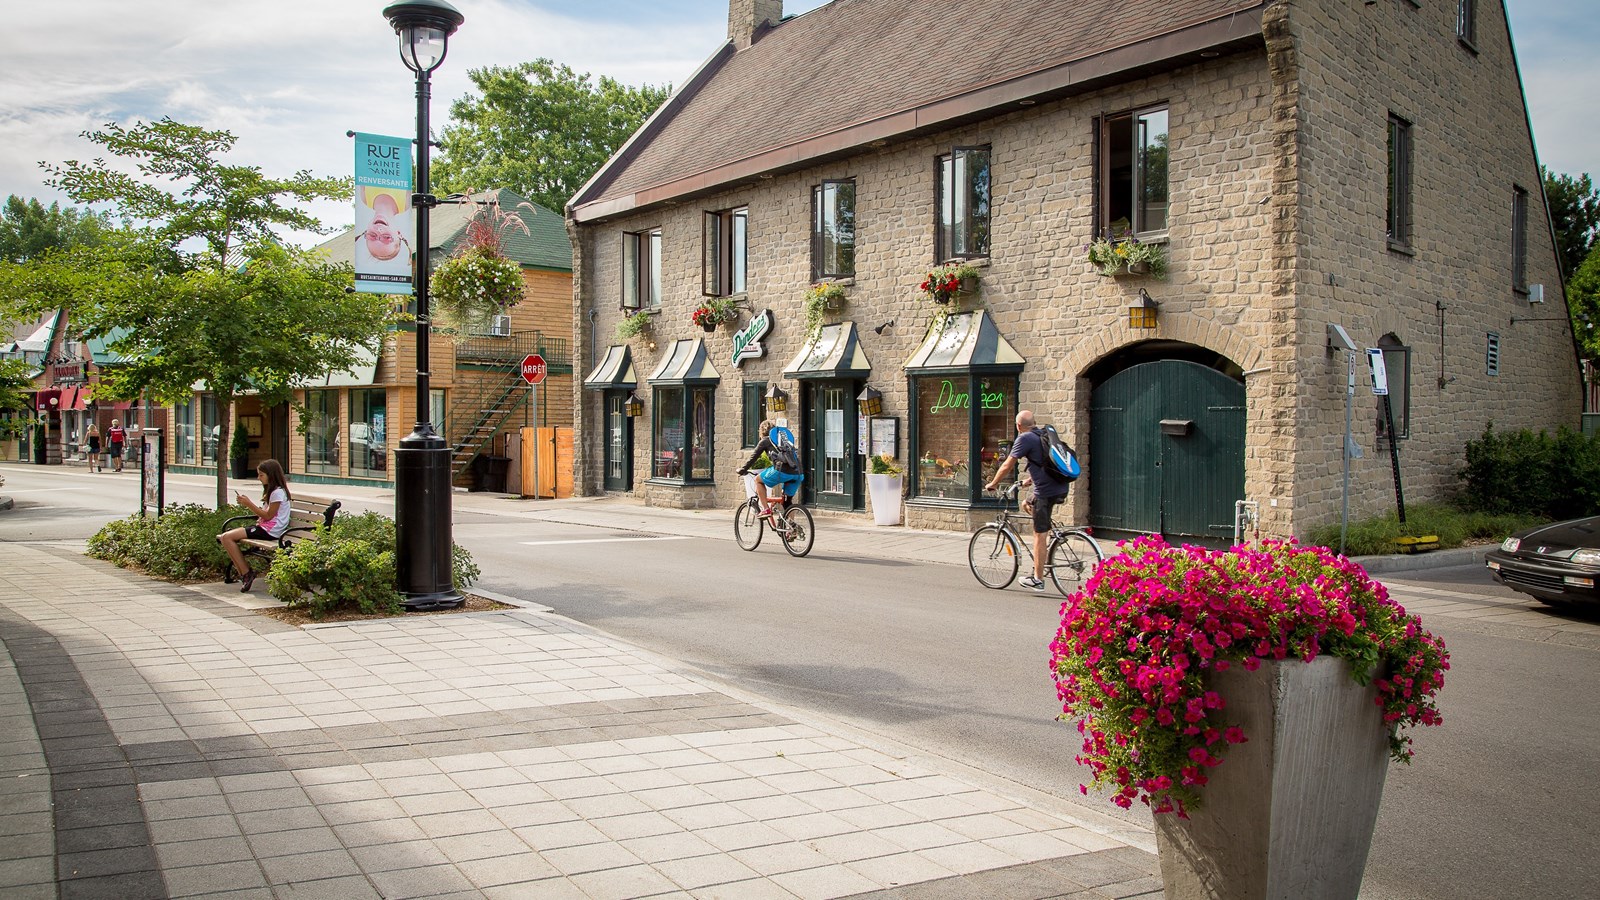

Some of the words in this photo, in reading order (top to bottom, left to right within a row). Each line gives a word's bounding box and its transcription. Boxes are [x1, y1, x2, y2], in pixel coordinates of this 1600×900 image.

[367, 144, 400, 160] RUE
[367, 159, 400, 169] SAINTE
[370, 168, 400, 177] ANNE
[358, 176, 409, 188] RENVERSANTE
[523, 363, 546, 374] ARRÊT
